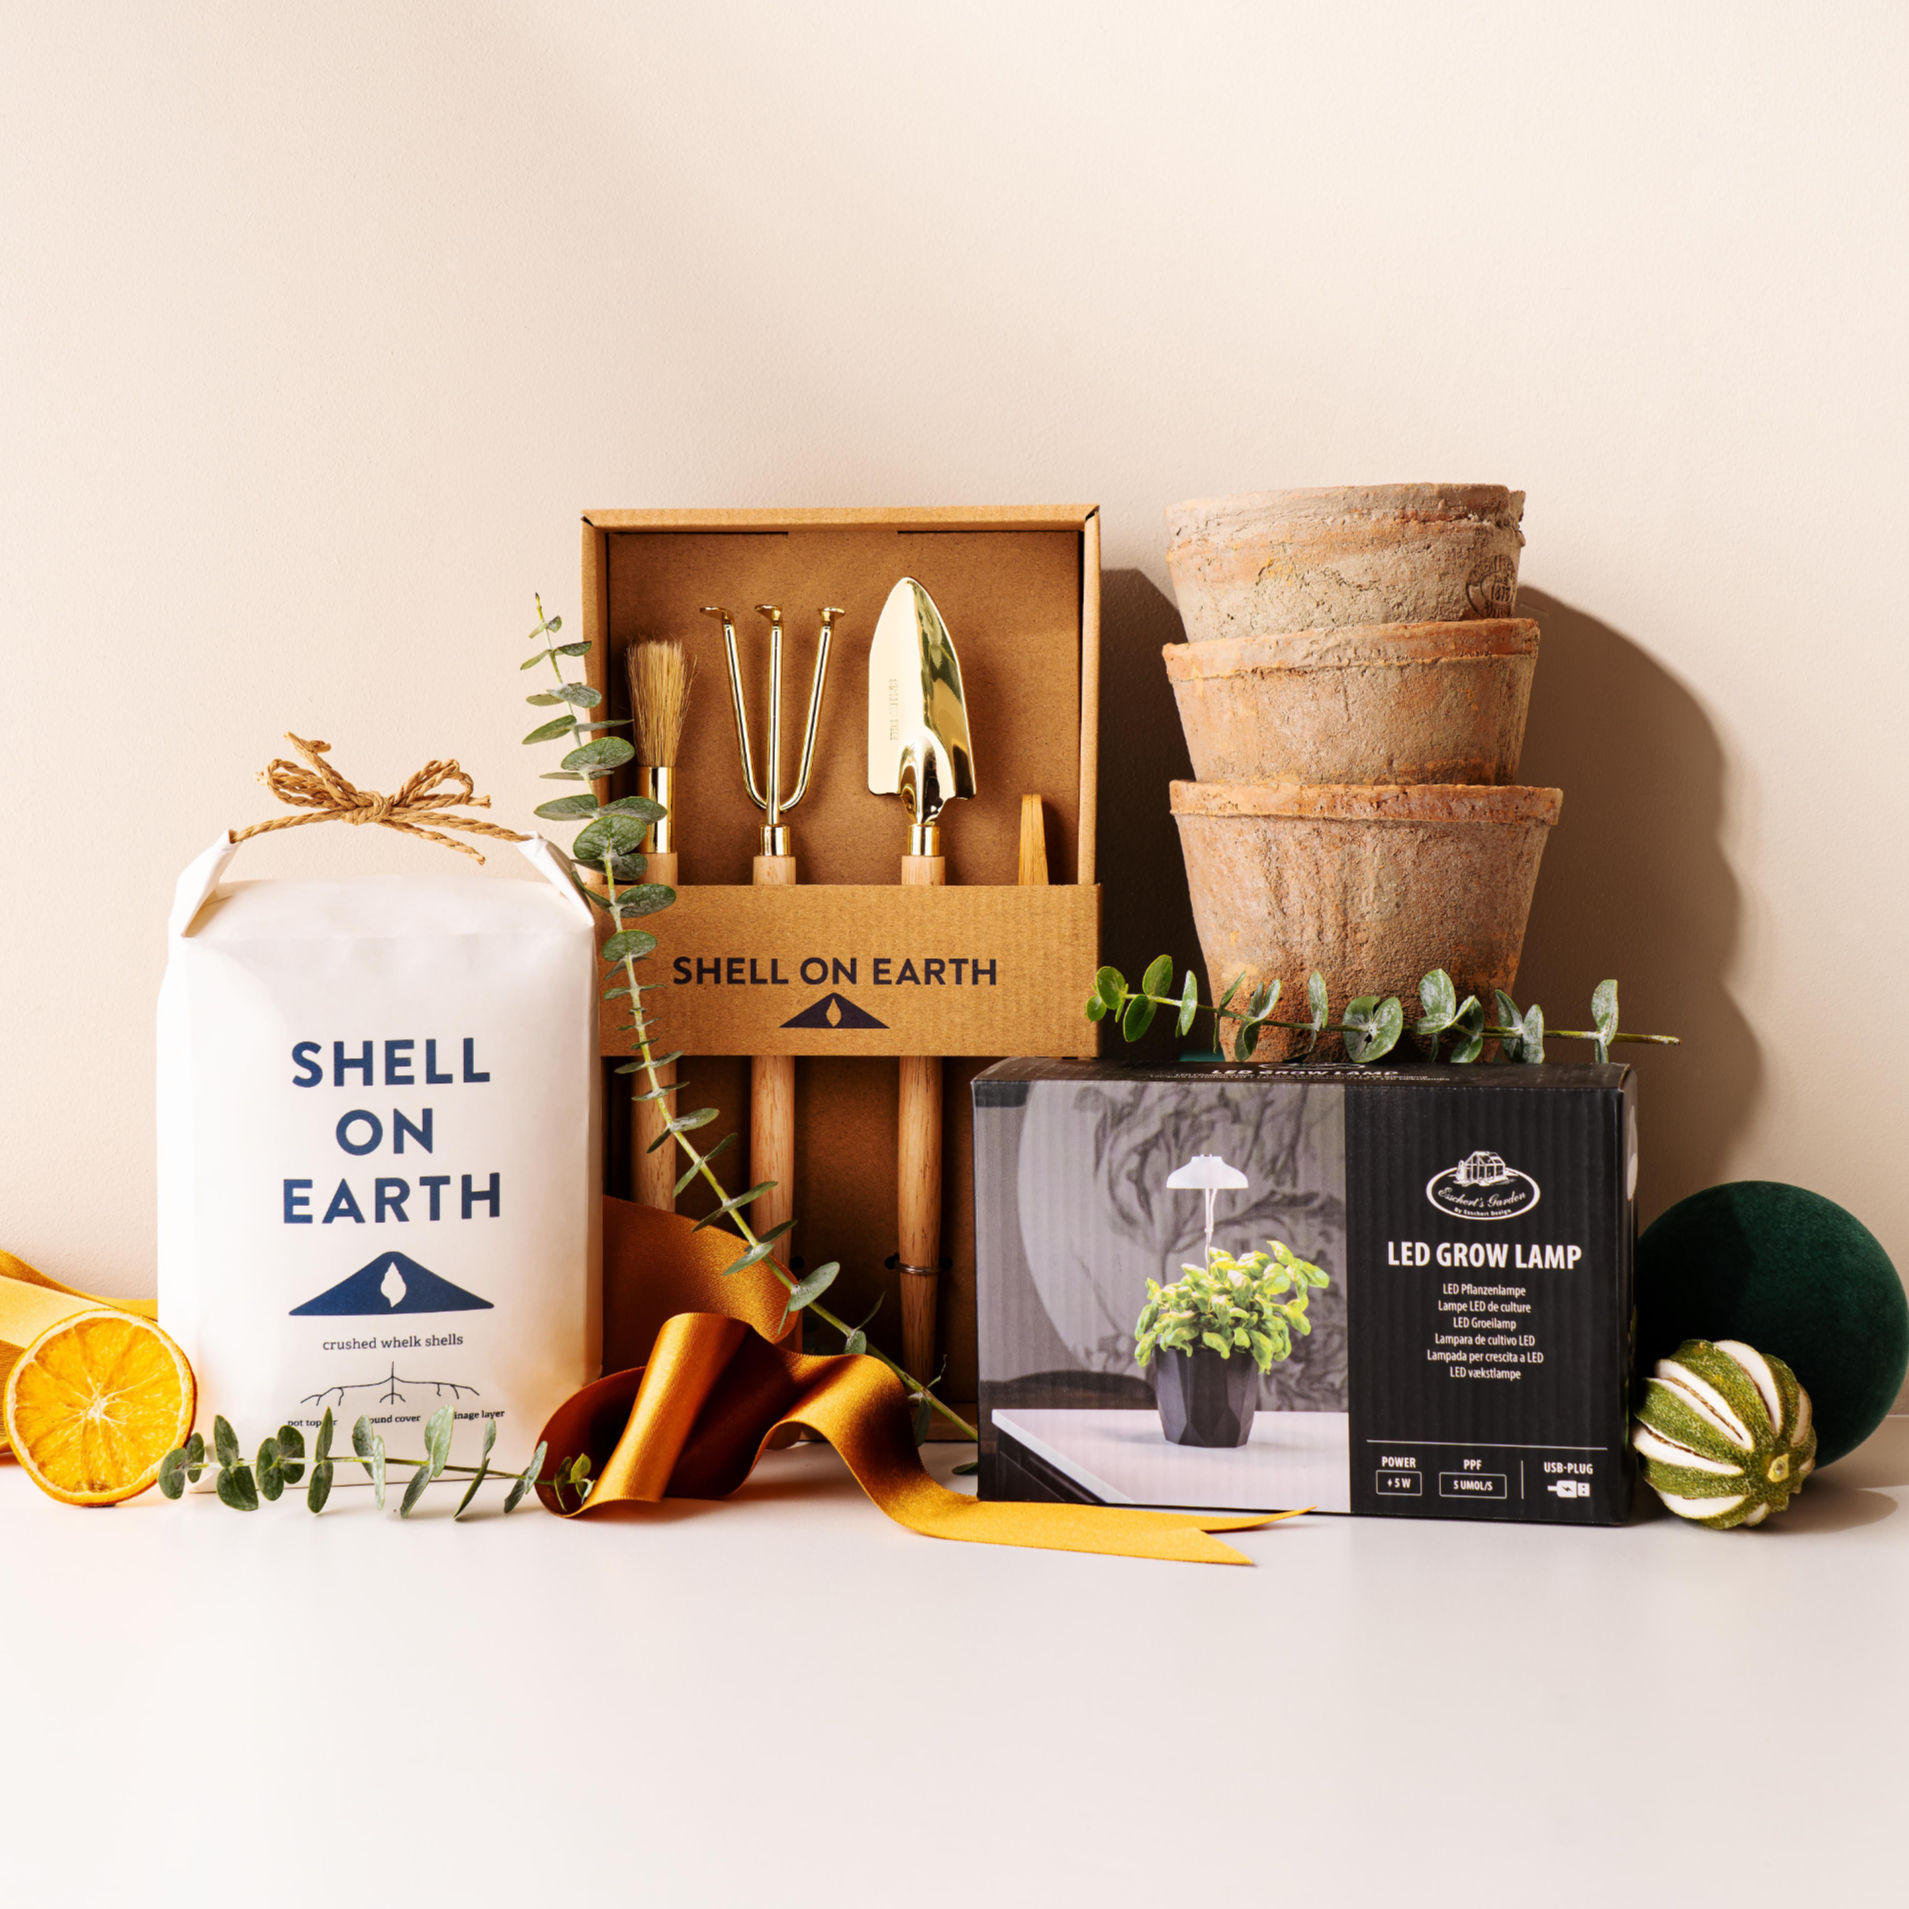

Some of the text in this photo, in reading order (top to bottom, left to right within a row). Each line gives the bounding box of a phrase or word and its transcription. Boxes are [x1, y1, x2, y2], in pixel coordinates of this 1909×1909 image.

[673, 956, 997, 986] SHELL ON EARTH
[291, 1037, 491, 1088] SHELL
[335, 1107, 434, 1156] ON
[283, 1172, 501, 1224] EARTH
[1487, 1190, 1527, 1208] Garden
[1387, 1241, 1583, 1270] LED GROW LAMP
[1442, 1283, 1527, 1298] LED Pflanzenlampe
[1438, 1299, 1532, 1314] Lampe LED de culture
[1453, 1317, 1517, 1332] LED Groeilamp
[322, 1333, 464, 1351] crushed whelk shells
[1434, 1333, 1536, 1347] Lampara de cultivo LED
[1426, 1349, 1544, 1364] Lampada per crescita a LED
[1449, 1366, 1522, 1381] LED vækstlampe
[481, 1410, 505, 1420] layer
[1381, 1456, 1417, 1469] POWER
[1463, 1459, 1483, 1471] PPF
[1543, 1461, 1594, 1475] USB-PLUG
[1401, 1478, 1412, 1489] W
[1460, 1480, 1494, 1492] UMOL/S
